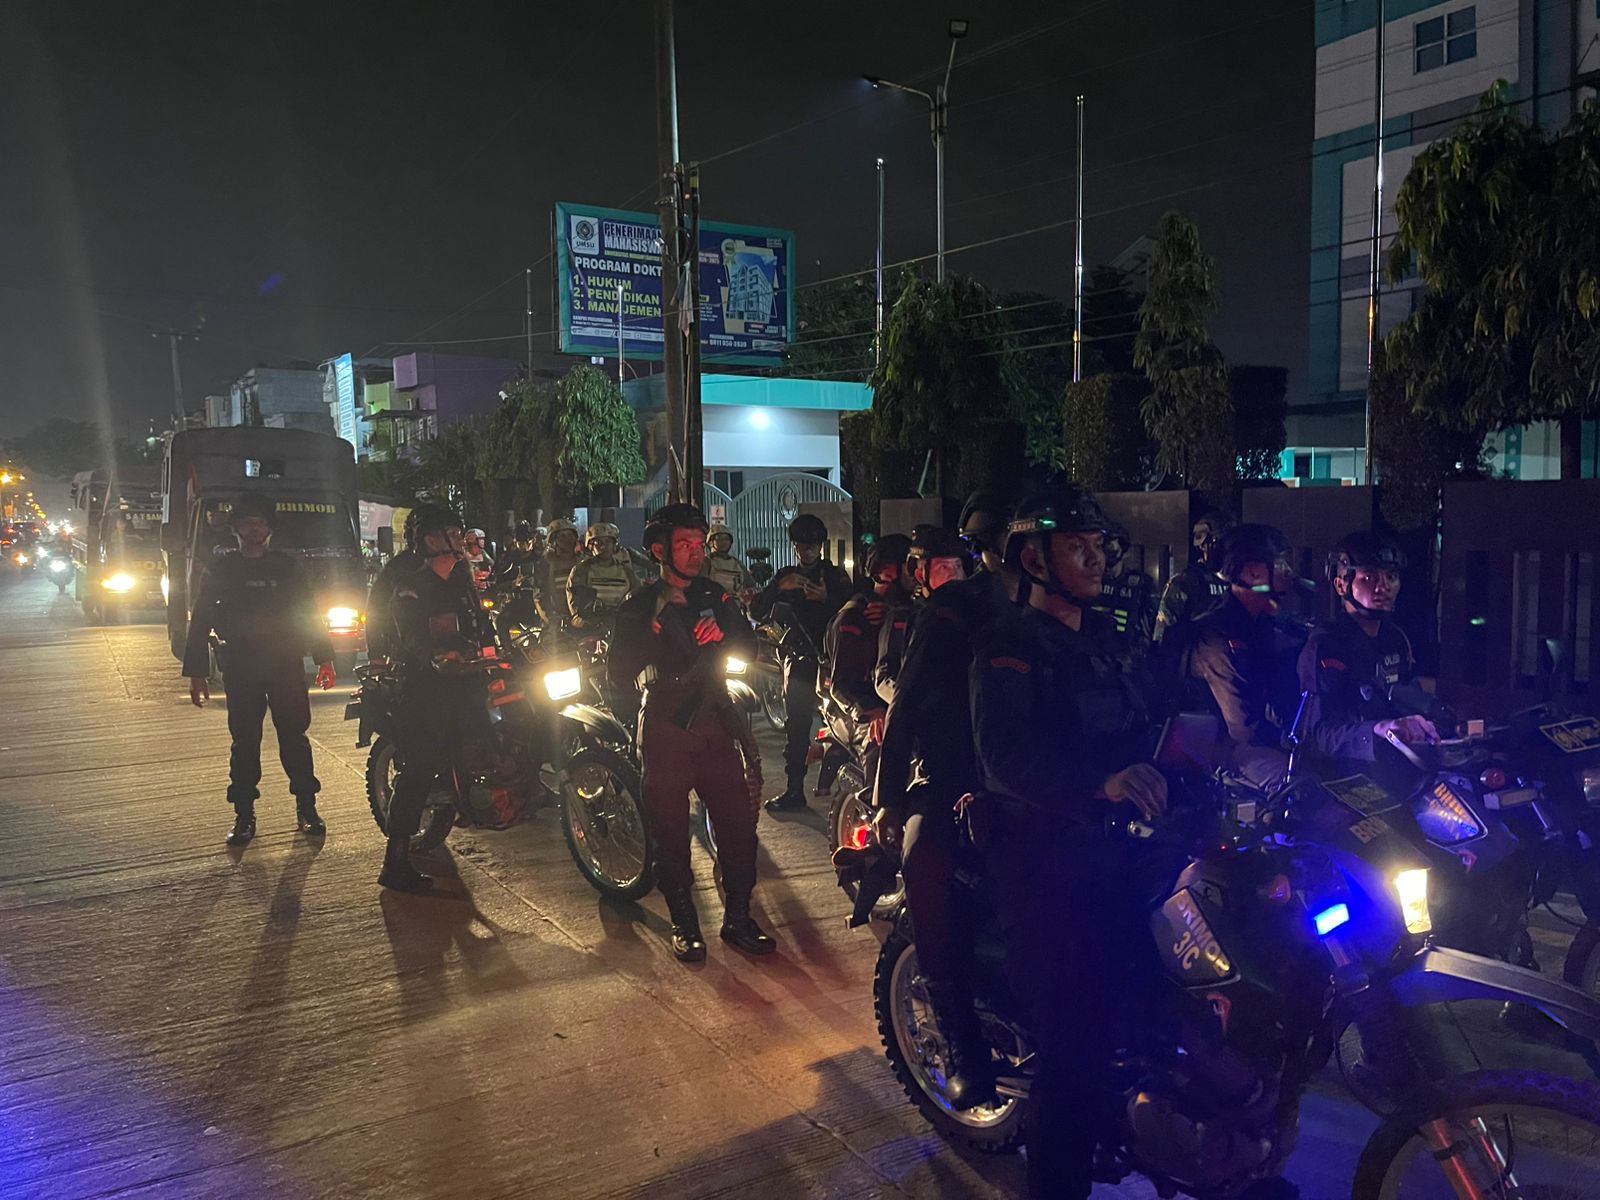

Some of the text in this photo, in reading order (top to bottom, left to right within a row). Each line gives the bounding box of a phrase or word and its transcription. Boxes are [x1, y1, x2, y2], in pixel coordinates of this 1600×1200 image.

[575, 256, 631, 273] PROGRAM
[573, 274, 632, 290] 1. HUKUM
[573, 287, 660, 305] 2. PENDDIKAN
[573, 299, 584, 310] 3.
[275, 502, 337, 514] BRIMOB
